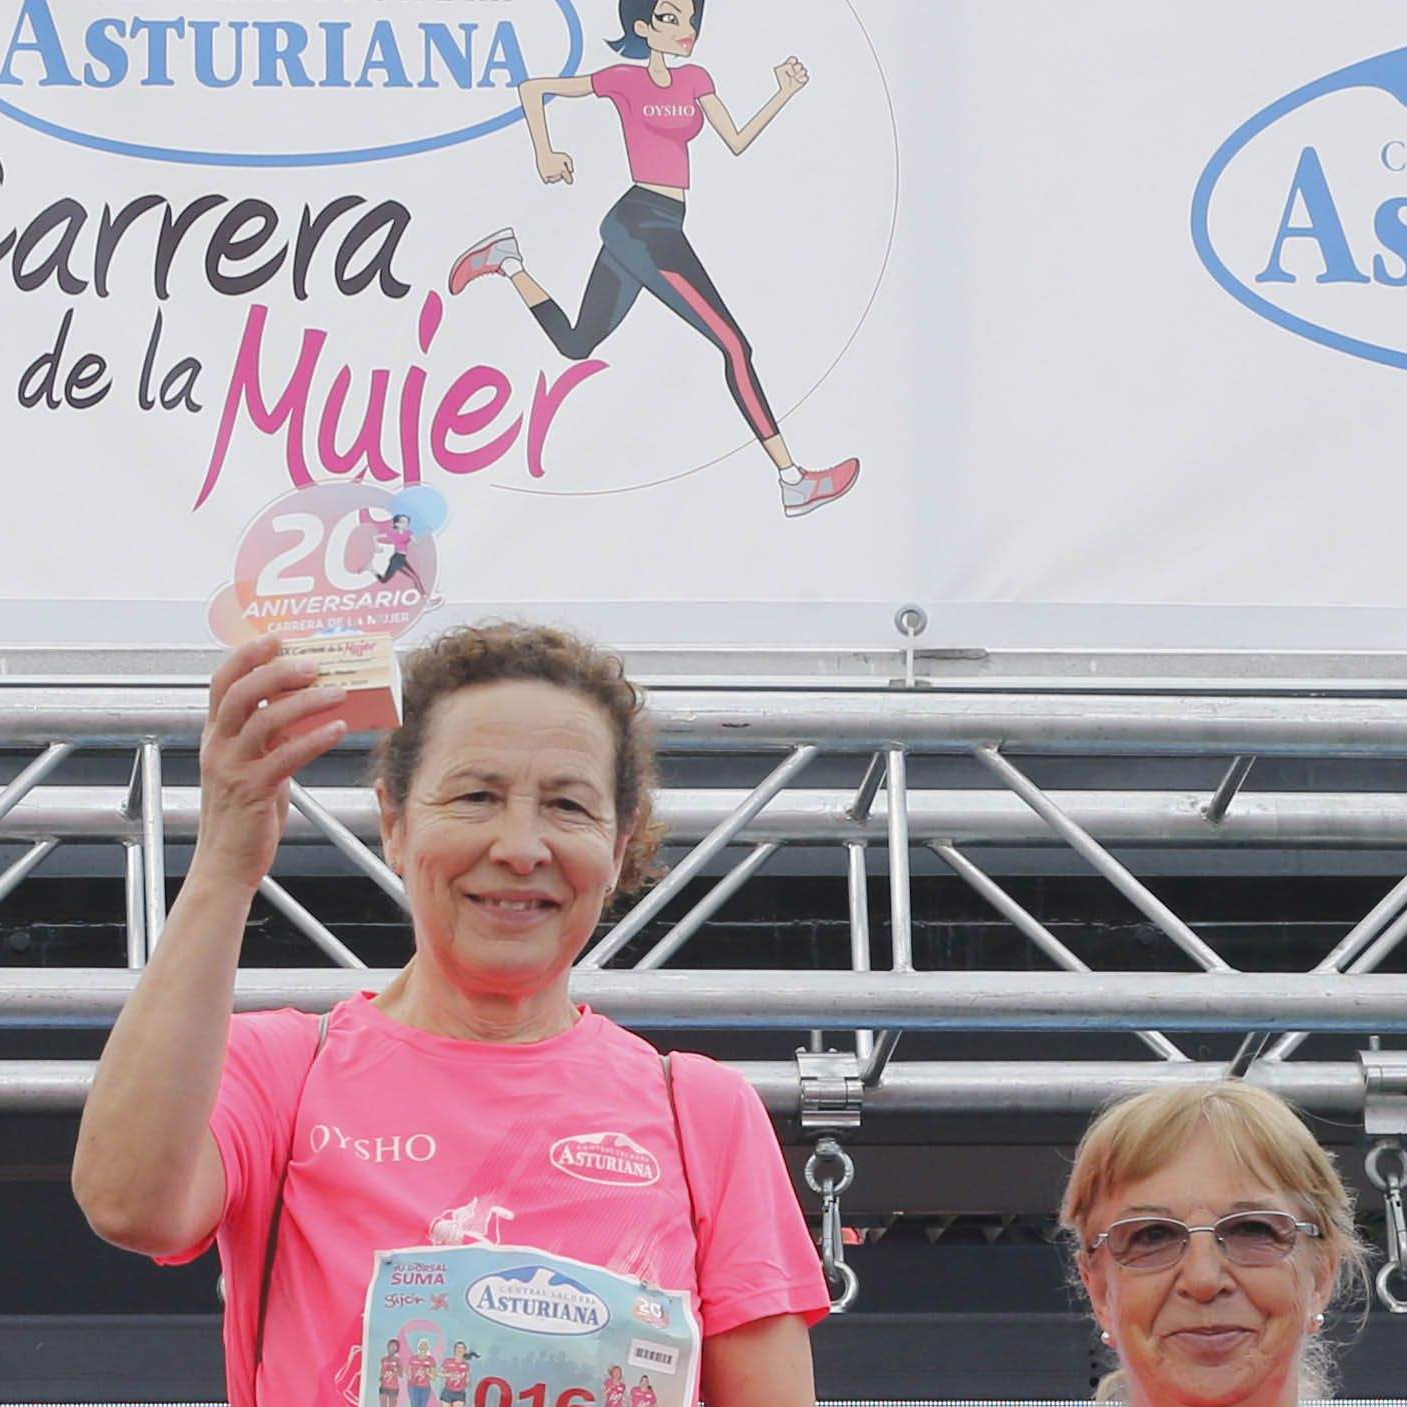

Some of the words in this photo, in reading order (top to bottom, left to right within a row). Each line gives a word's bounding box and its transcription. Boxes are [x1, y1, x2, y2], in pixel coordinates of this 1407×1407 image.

[643, 105, 695, 117] OYSHO
[17, 307, 112, 411] de
[138, 310, 204, 413] la
[193, 290, 611, 512] Mujer
[242, 588, 421, 619] ANIVERSARIO
[267, 620, 324, 633] CARRERA
[309, 1123, 438, 1163] OYSHO
[558, 1145, 653, 1180] ASTURIANA
[390, 1271, 445, 1286] SUMA
[476, 1284, 599, 1327] ASTURIANA
